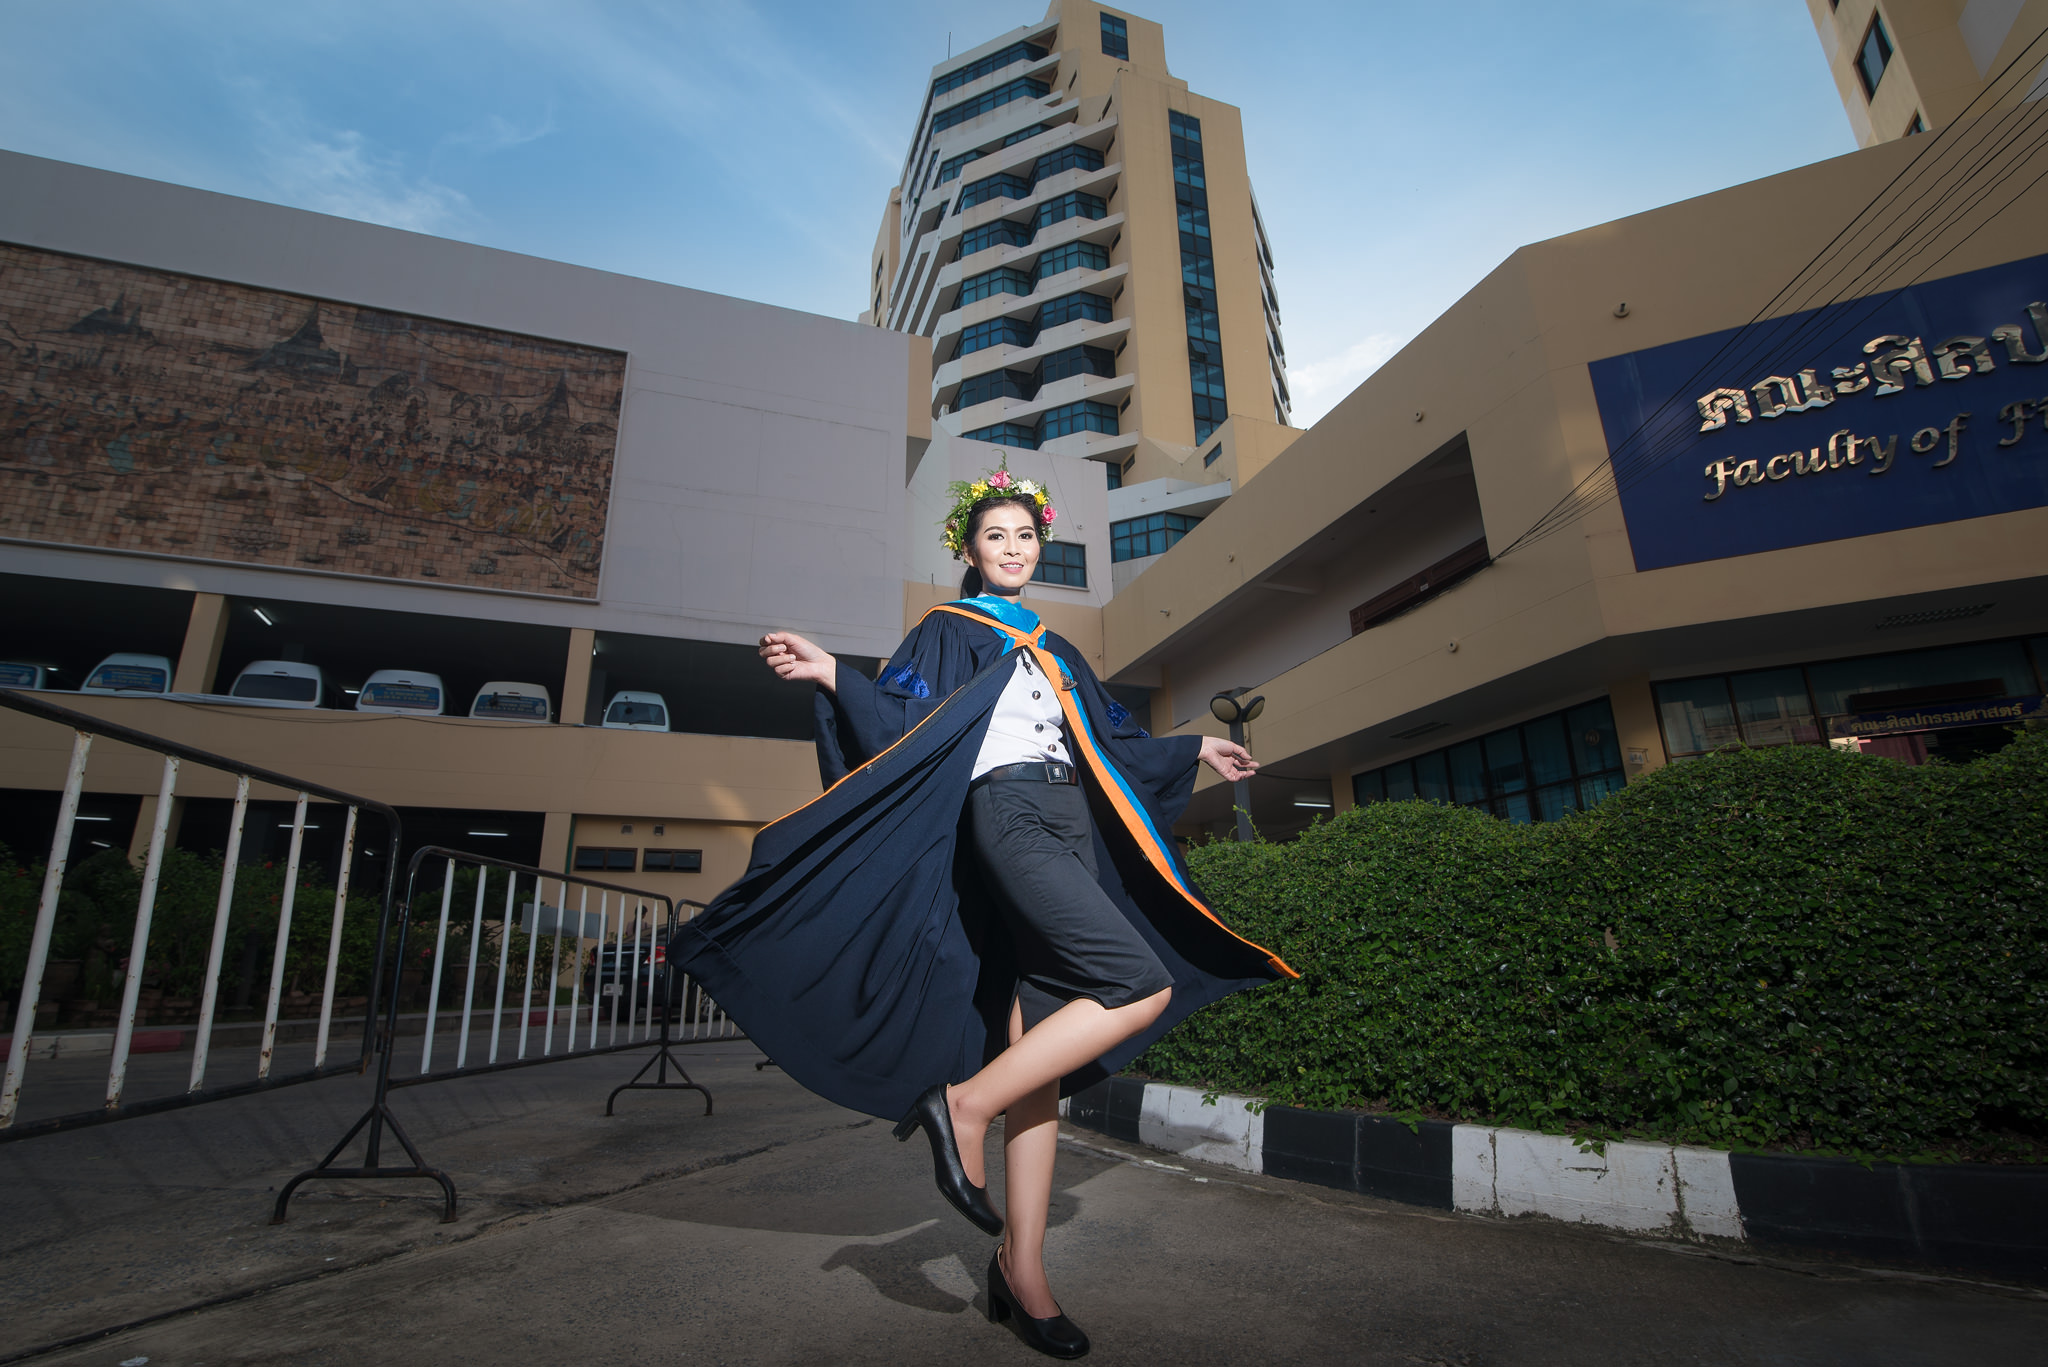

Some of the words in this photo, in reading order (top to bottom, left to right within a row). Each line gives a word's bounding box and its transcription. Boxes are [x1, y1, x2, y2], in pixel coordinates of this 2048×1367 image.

[1704, 429, 1898, 500] Faculty
[1910, 412, 1973, 467] of
[1850, 702, 2024, 733] คณะศิลปกรรมศาสตร์
